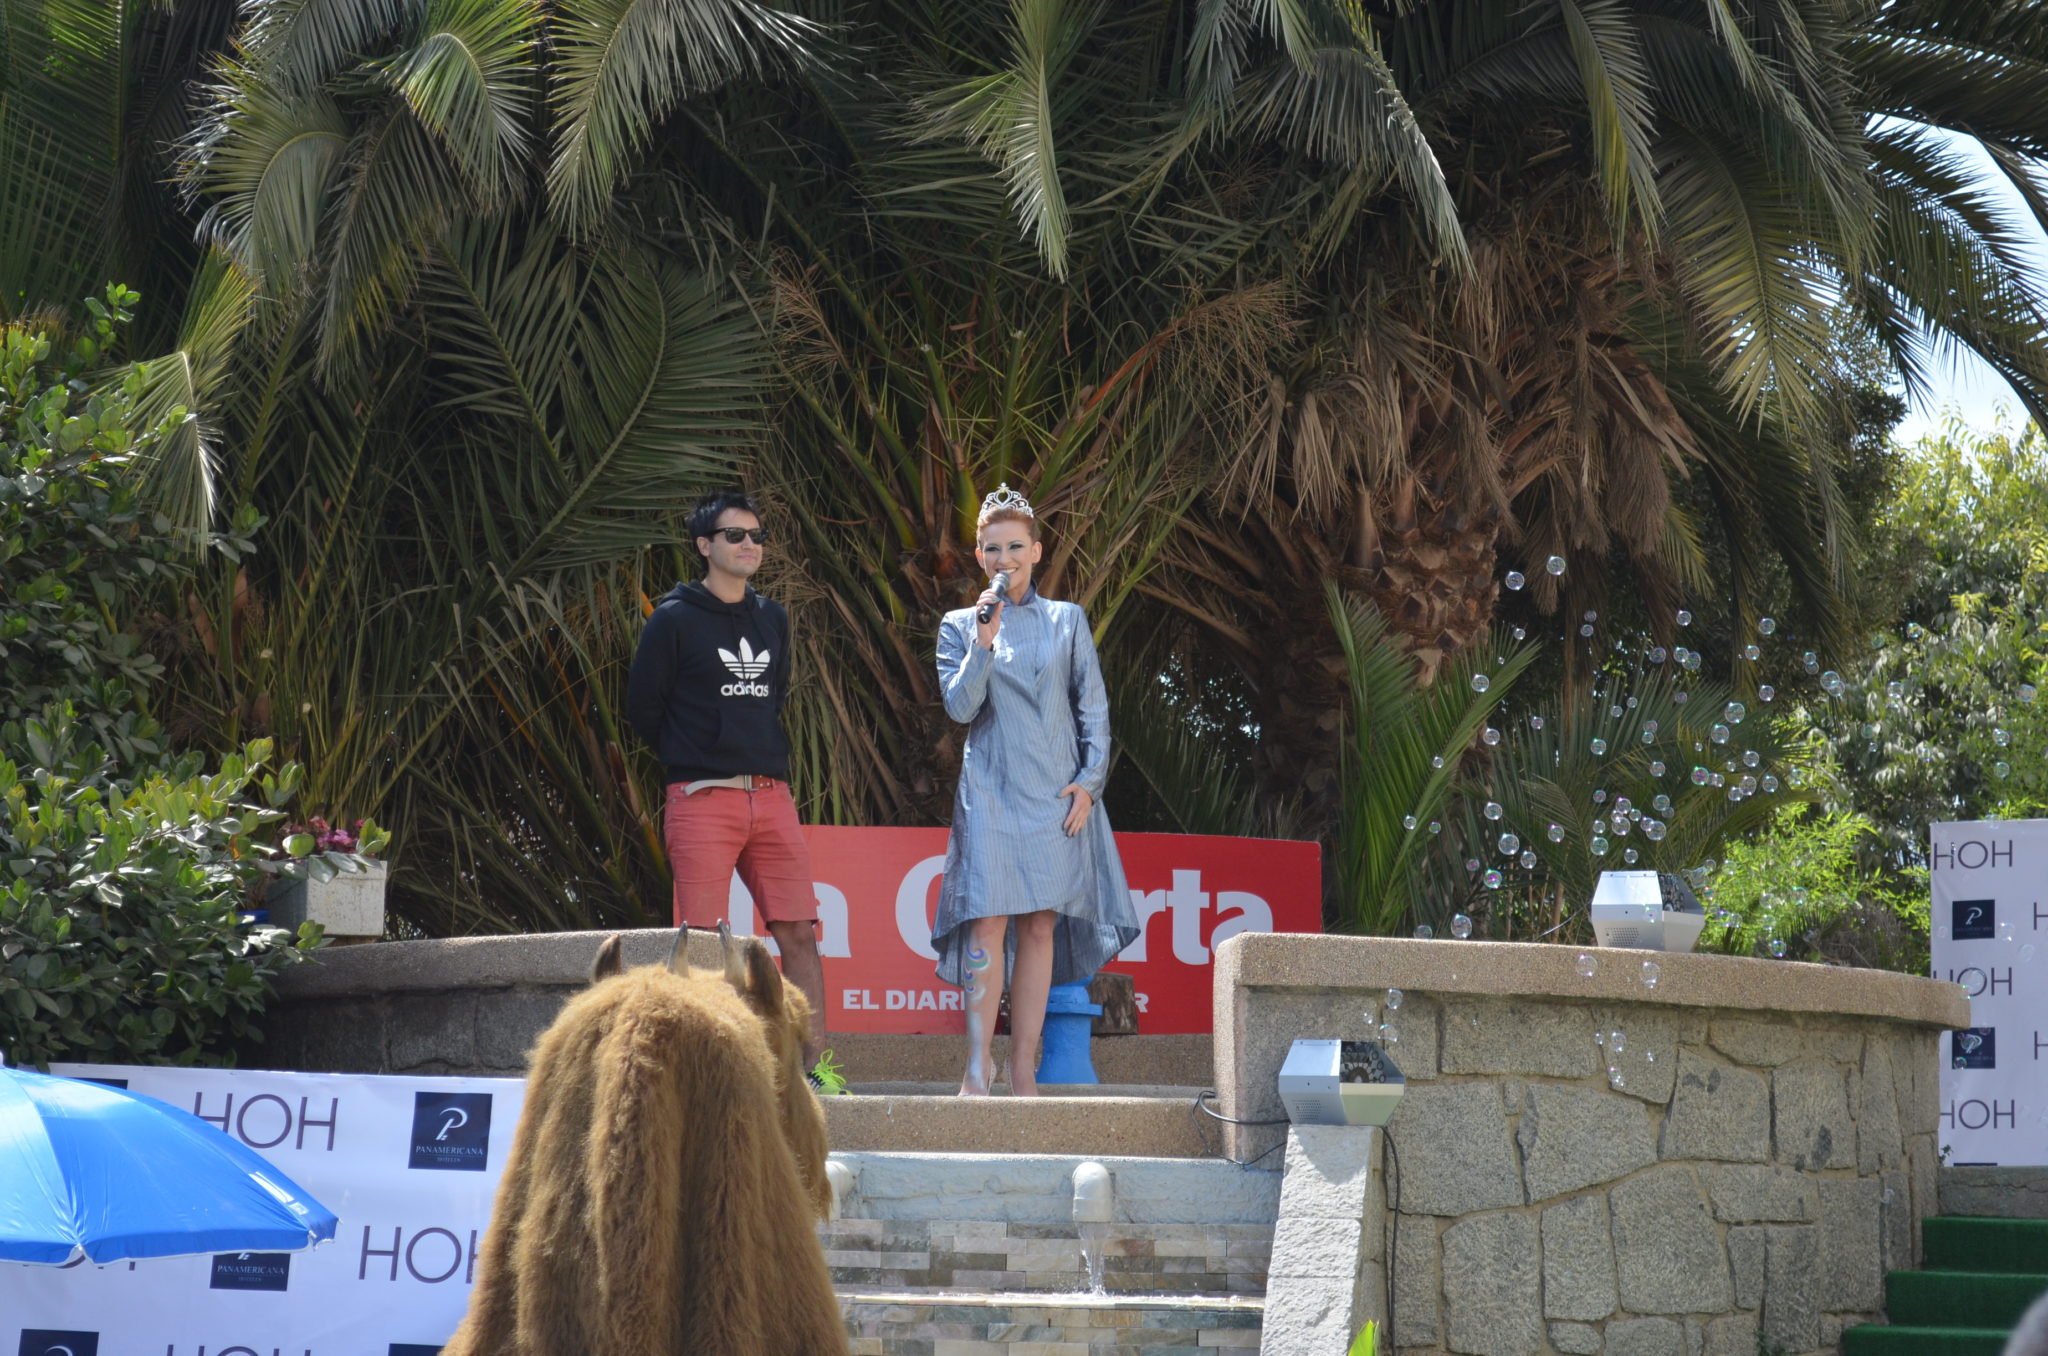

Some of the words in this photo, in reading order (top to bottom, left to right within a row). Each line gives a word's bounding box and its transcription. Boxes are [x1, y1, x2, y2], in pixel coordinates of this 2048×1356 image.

[720, 681, 769, 698] adidas
[1934, 838, 2013, 870] HOH
[1933, 967, 2013, 997] OH
[843, 989, 880, 1010] EL
[885, 990, 966, 1011] DIARI
[193, 1091, 339, 1152] HOH
[415, 1145, 484, 1157] PANAMERICANA
[217, 1264, 285, 1275] PANAMERICANA
